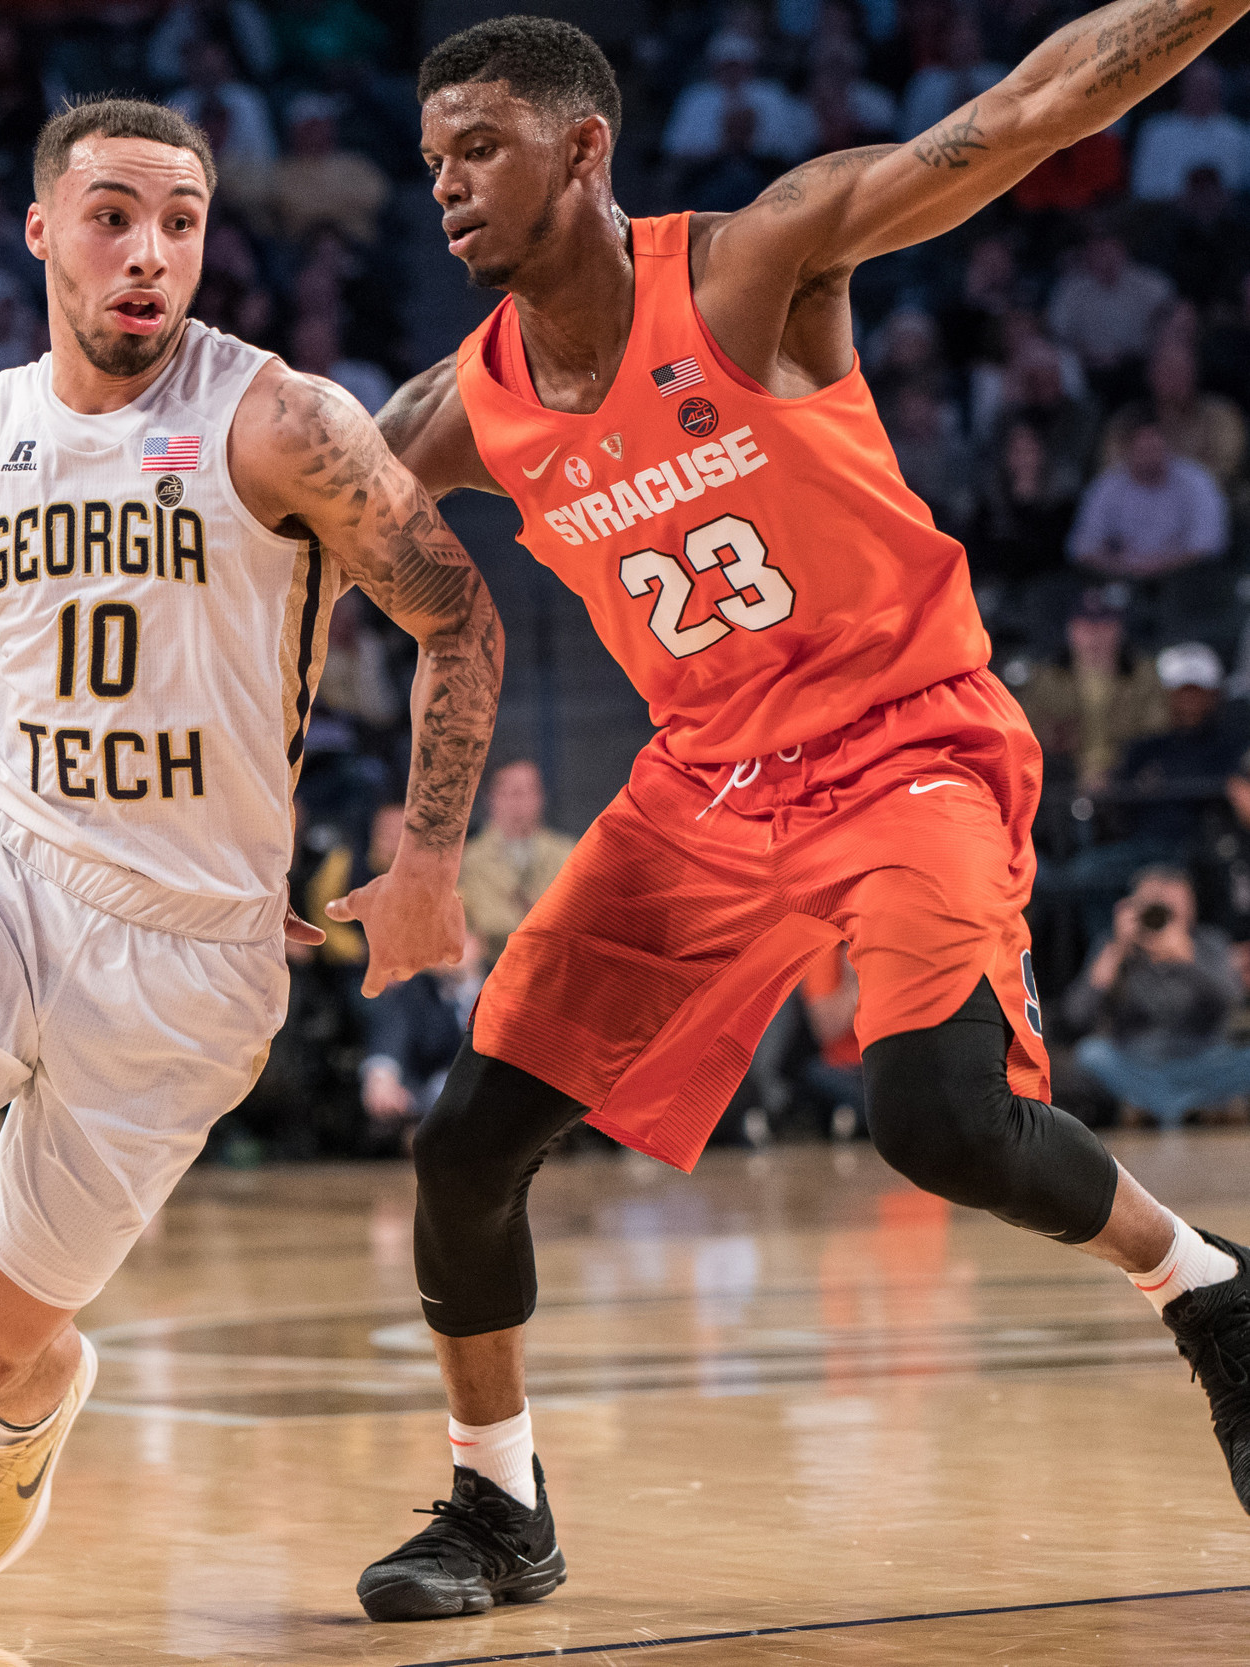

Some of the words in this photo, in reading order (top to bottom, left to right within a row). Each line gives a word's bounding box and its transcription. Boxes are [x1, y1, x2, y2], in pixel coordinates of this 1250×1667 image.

[686, 406, 713, 424] ACC
[1, 463, 38, 472] RUSSELL
[544, 425, 769, 546] SYRACUSE
[619, 513, 797, 660] 23
[56, 598, 141, 701] 10
[17, 718, 205, 802] TECH
